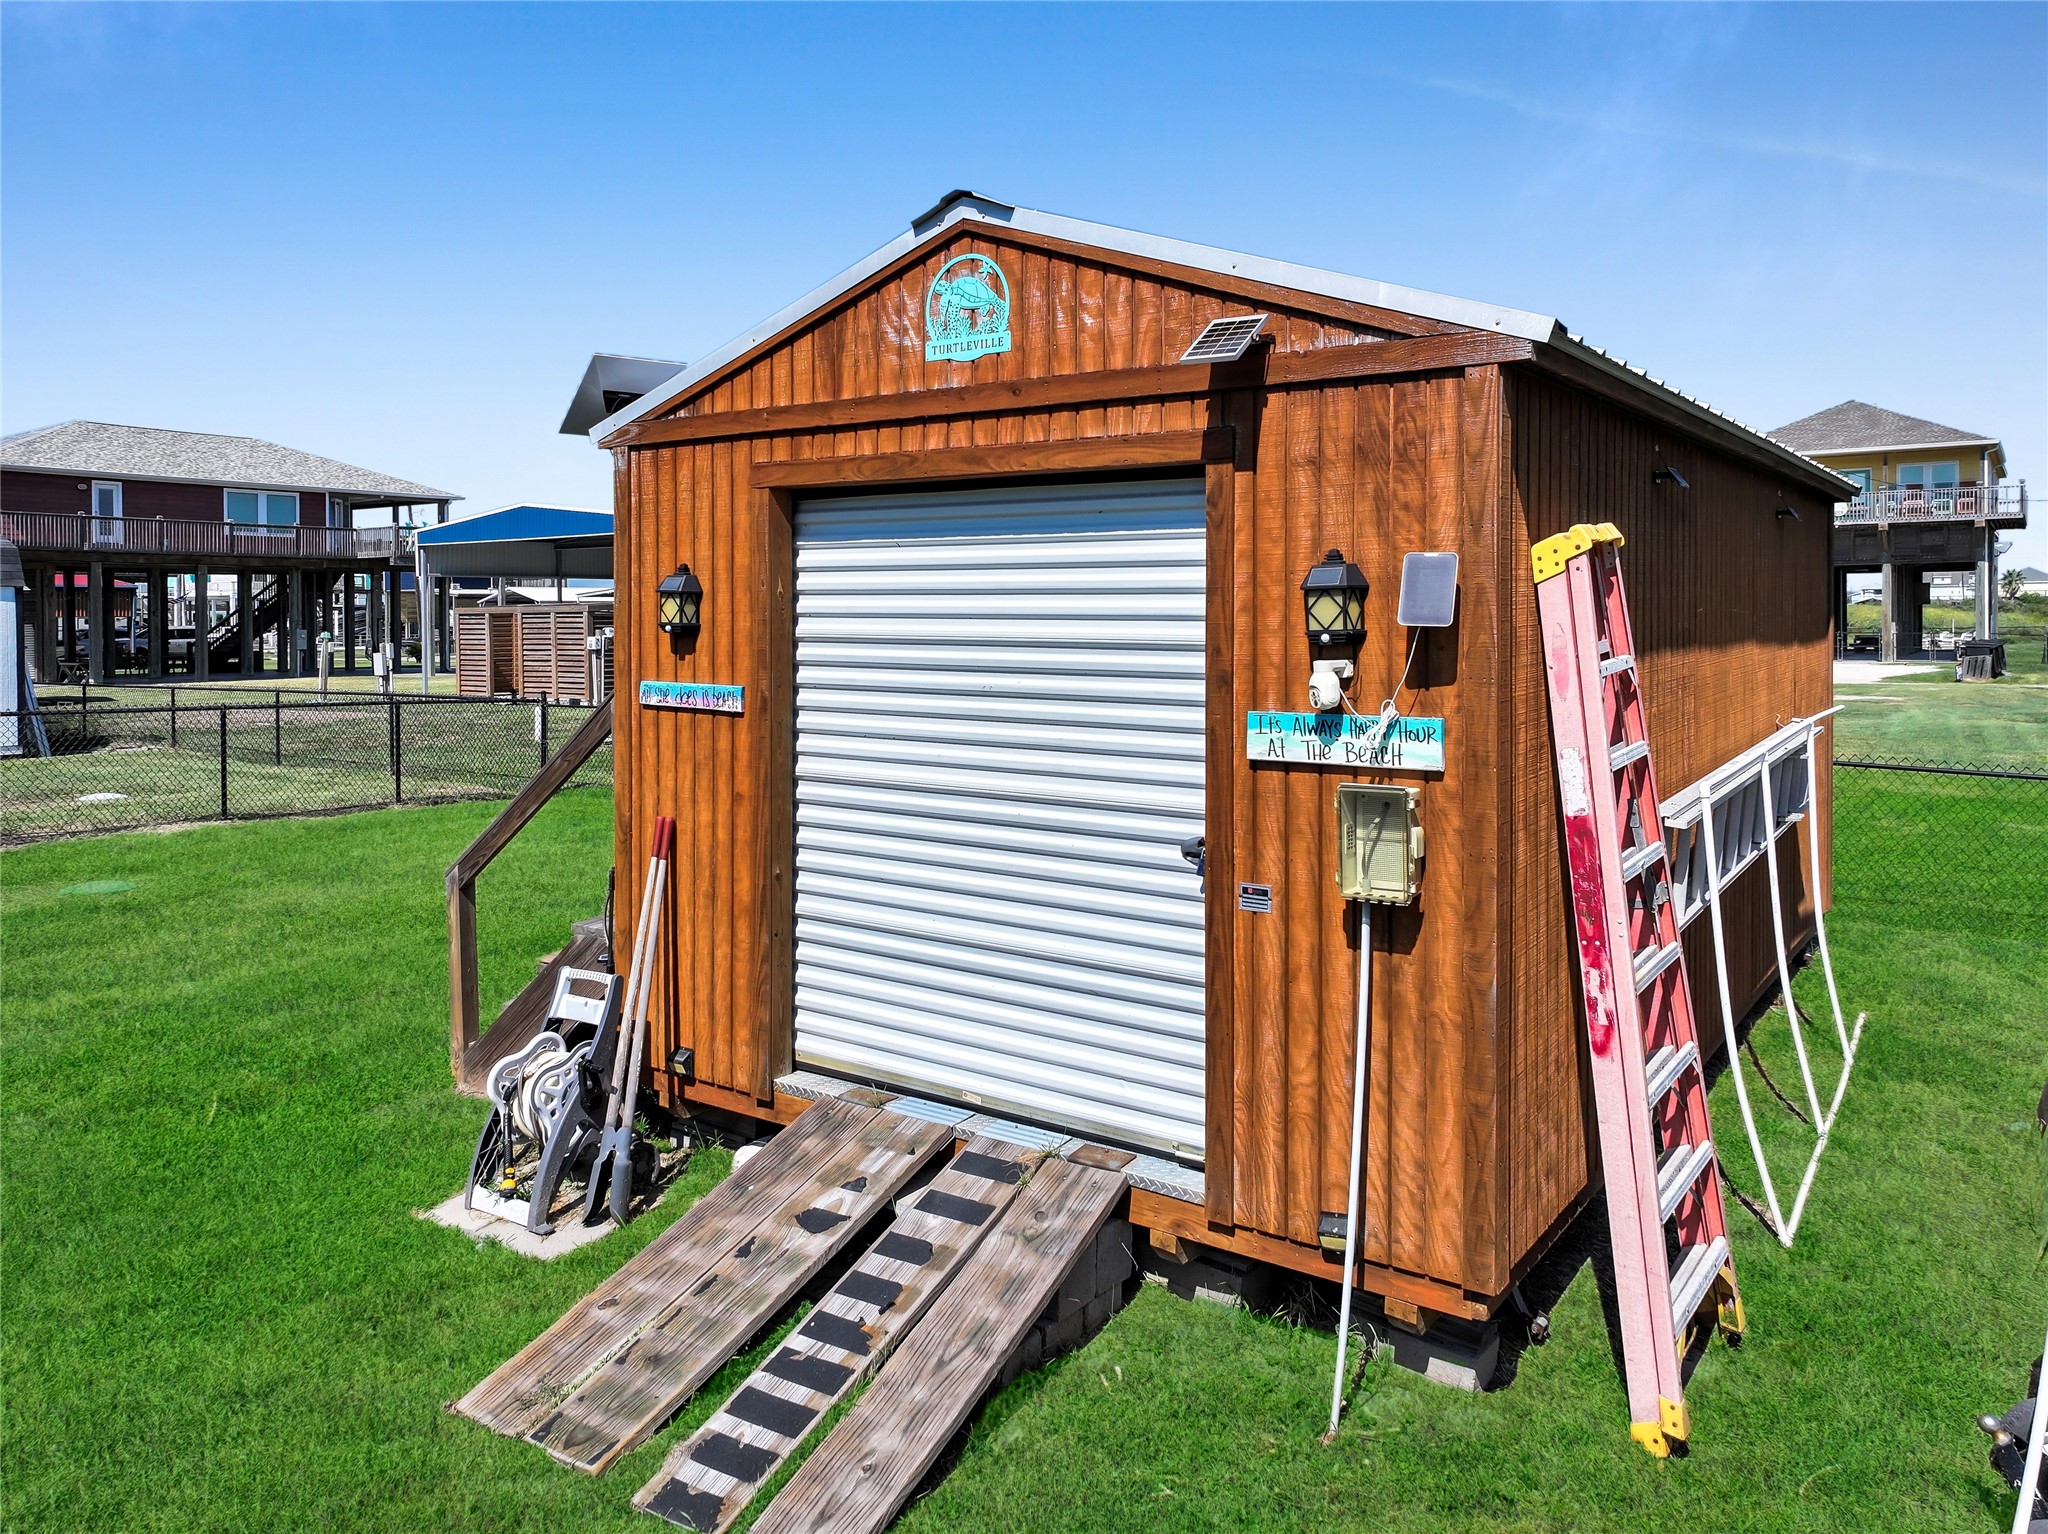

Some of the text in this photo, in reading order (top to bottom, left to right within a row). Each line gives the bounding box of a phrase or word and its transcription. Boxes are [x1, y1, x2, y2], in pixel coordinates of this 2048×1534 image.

[931, 336, 1004, 356] TURTLEVILLE
[674, 686, 698, 707] does
[1253, 714, 1283, 735] It's
[1348, 716, 1392, 741] HAP
